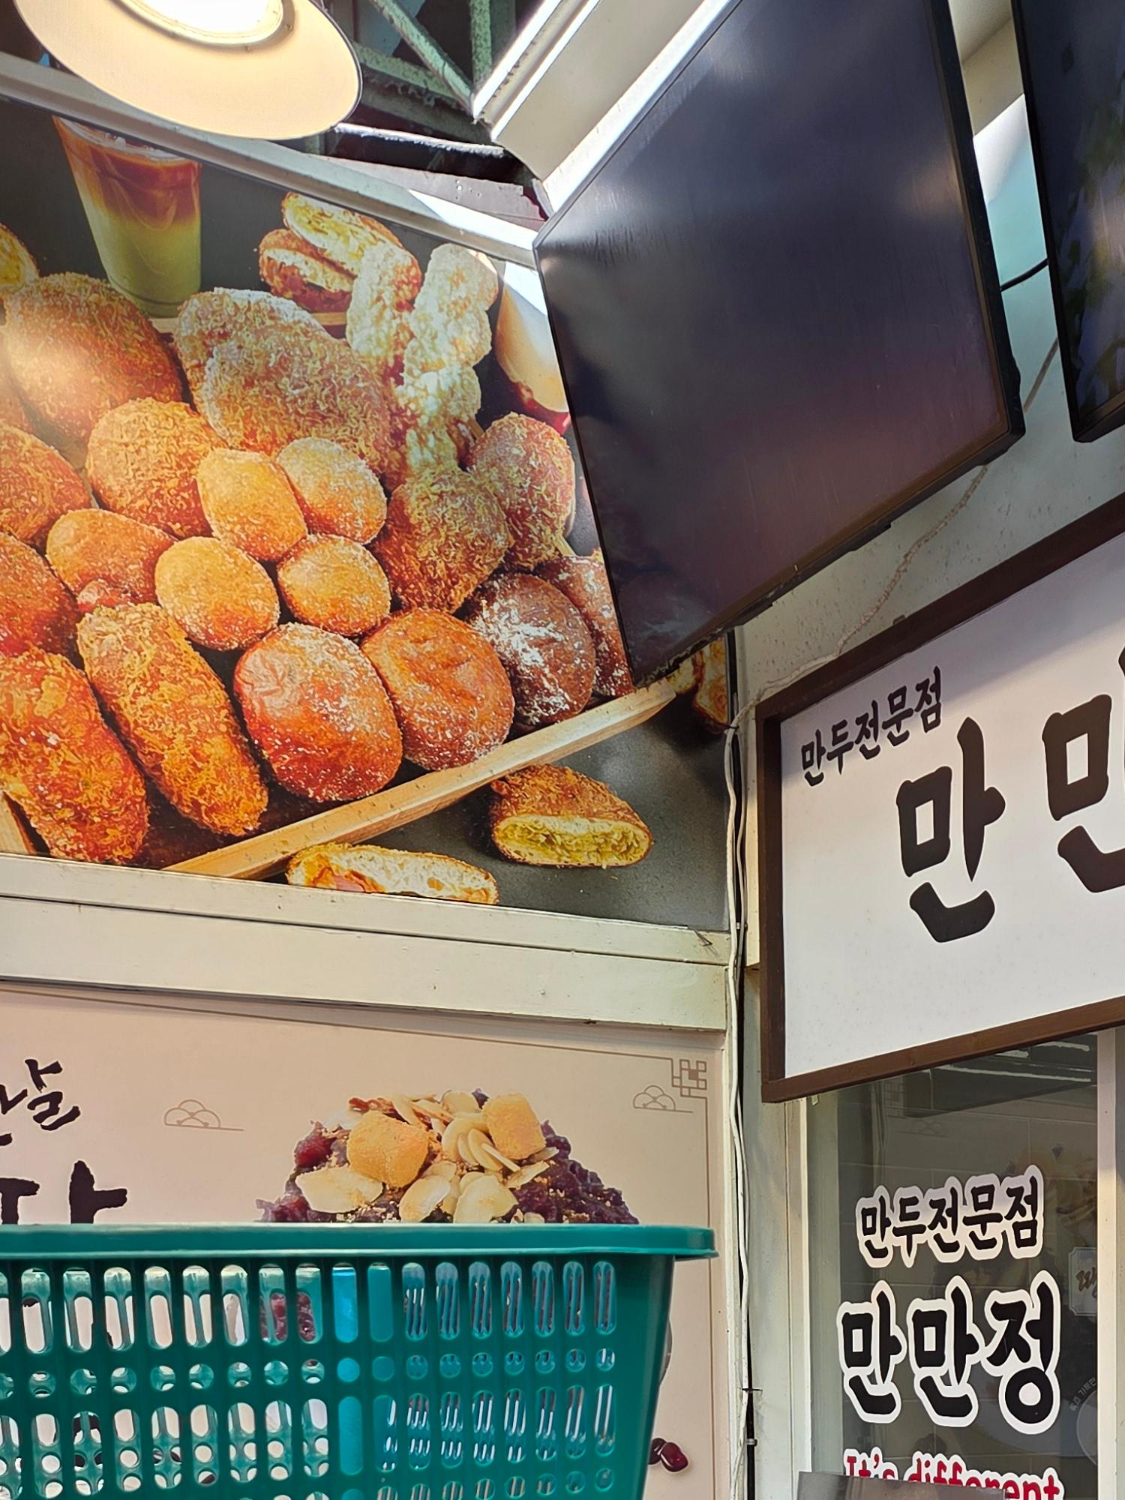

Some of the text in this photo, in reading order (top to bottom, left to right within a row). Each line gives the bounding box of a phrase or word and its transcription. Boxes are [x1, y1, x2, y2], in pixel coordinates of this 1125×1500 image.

[800, 665, 944, 787] 만두전문점
[861, 1174, 1039, 1256] 만두전문점
[841, 1281, 1054, 1424] 만만정
